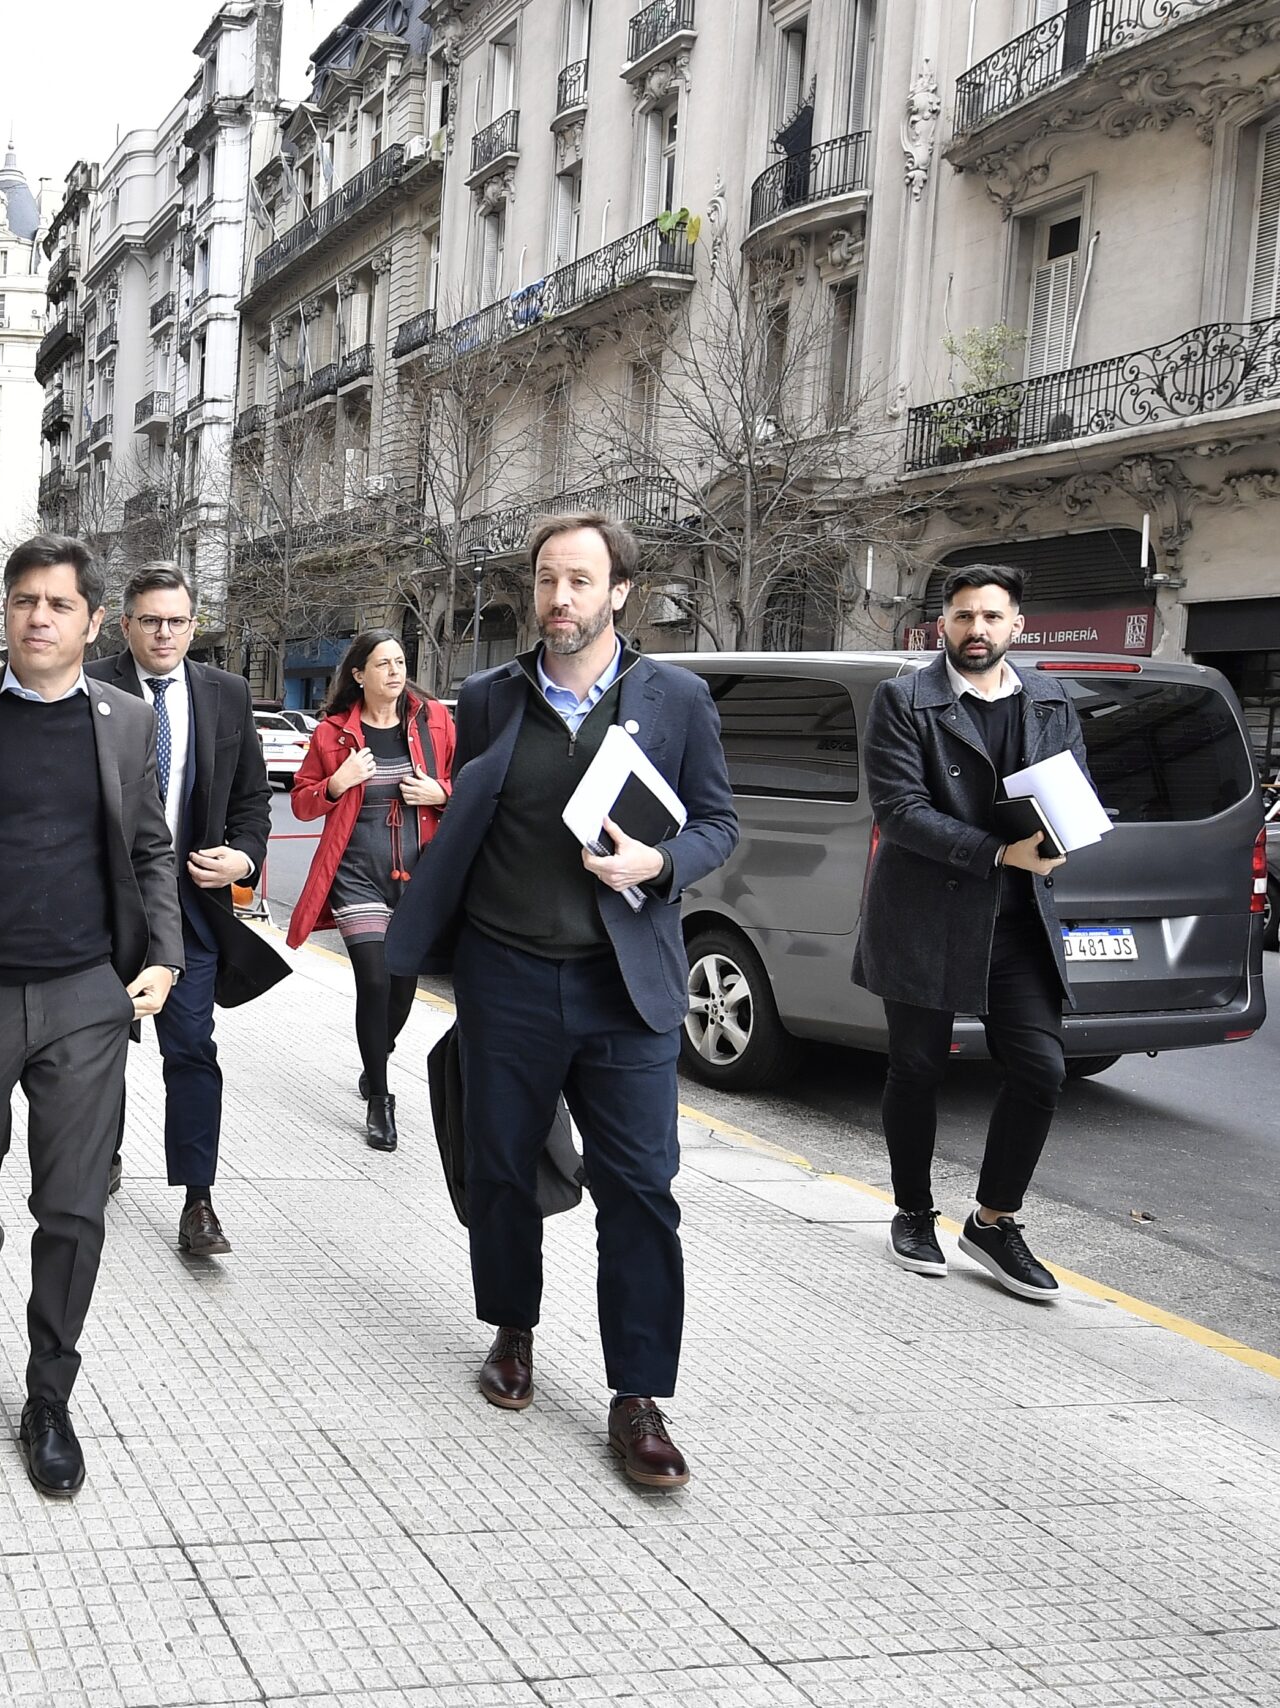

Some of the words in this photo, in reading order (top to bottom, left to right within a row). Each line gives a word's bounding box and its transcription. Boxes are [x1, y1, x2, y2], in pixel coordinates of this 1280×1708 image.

[1010, 632, 1041, 644] AIRES
[1048, 626, 1099, 643] LIBRERÍA
[1063, 939, 1073, 956] D
[1078, 938, 1107, 956] 481
[1113, 937, 1132, 955] JS
